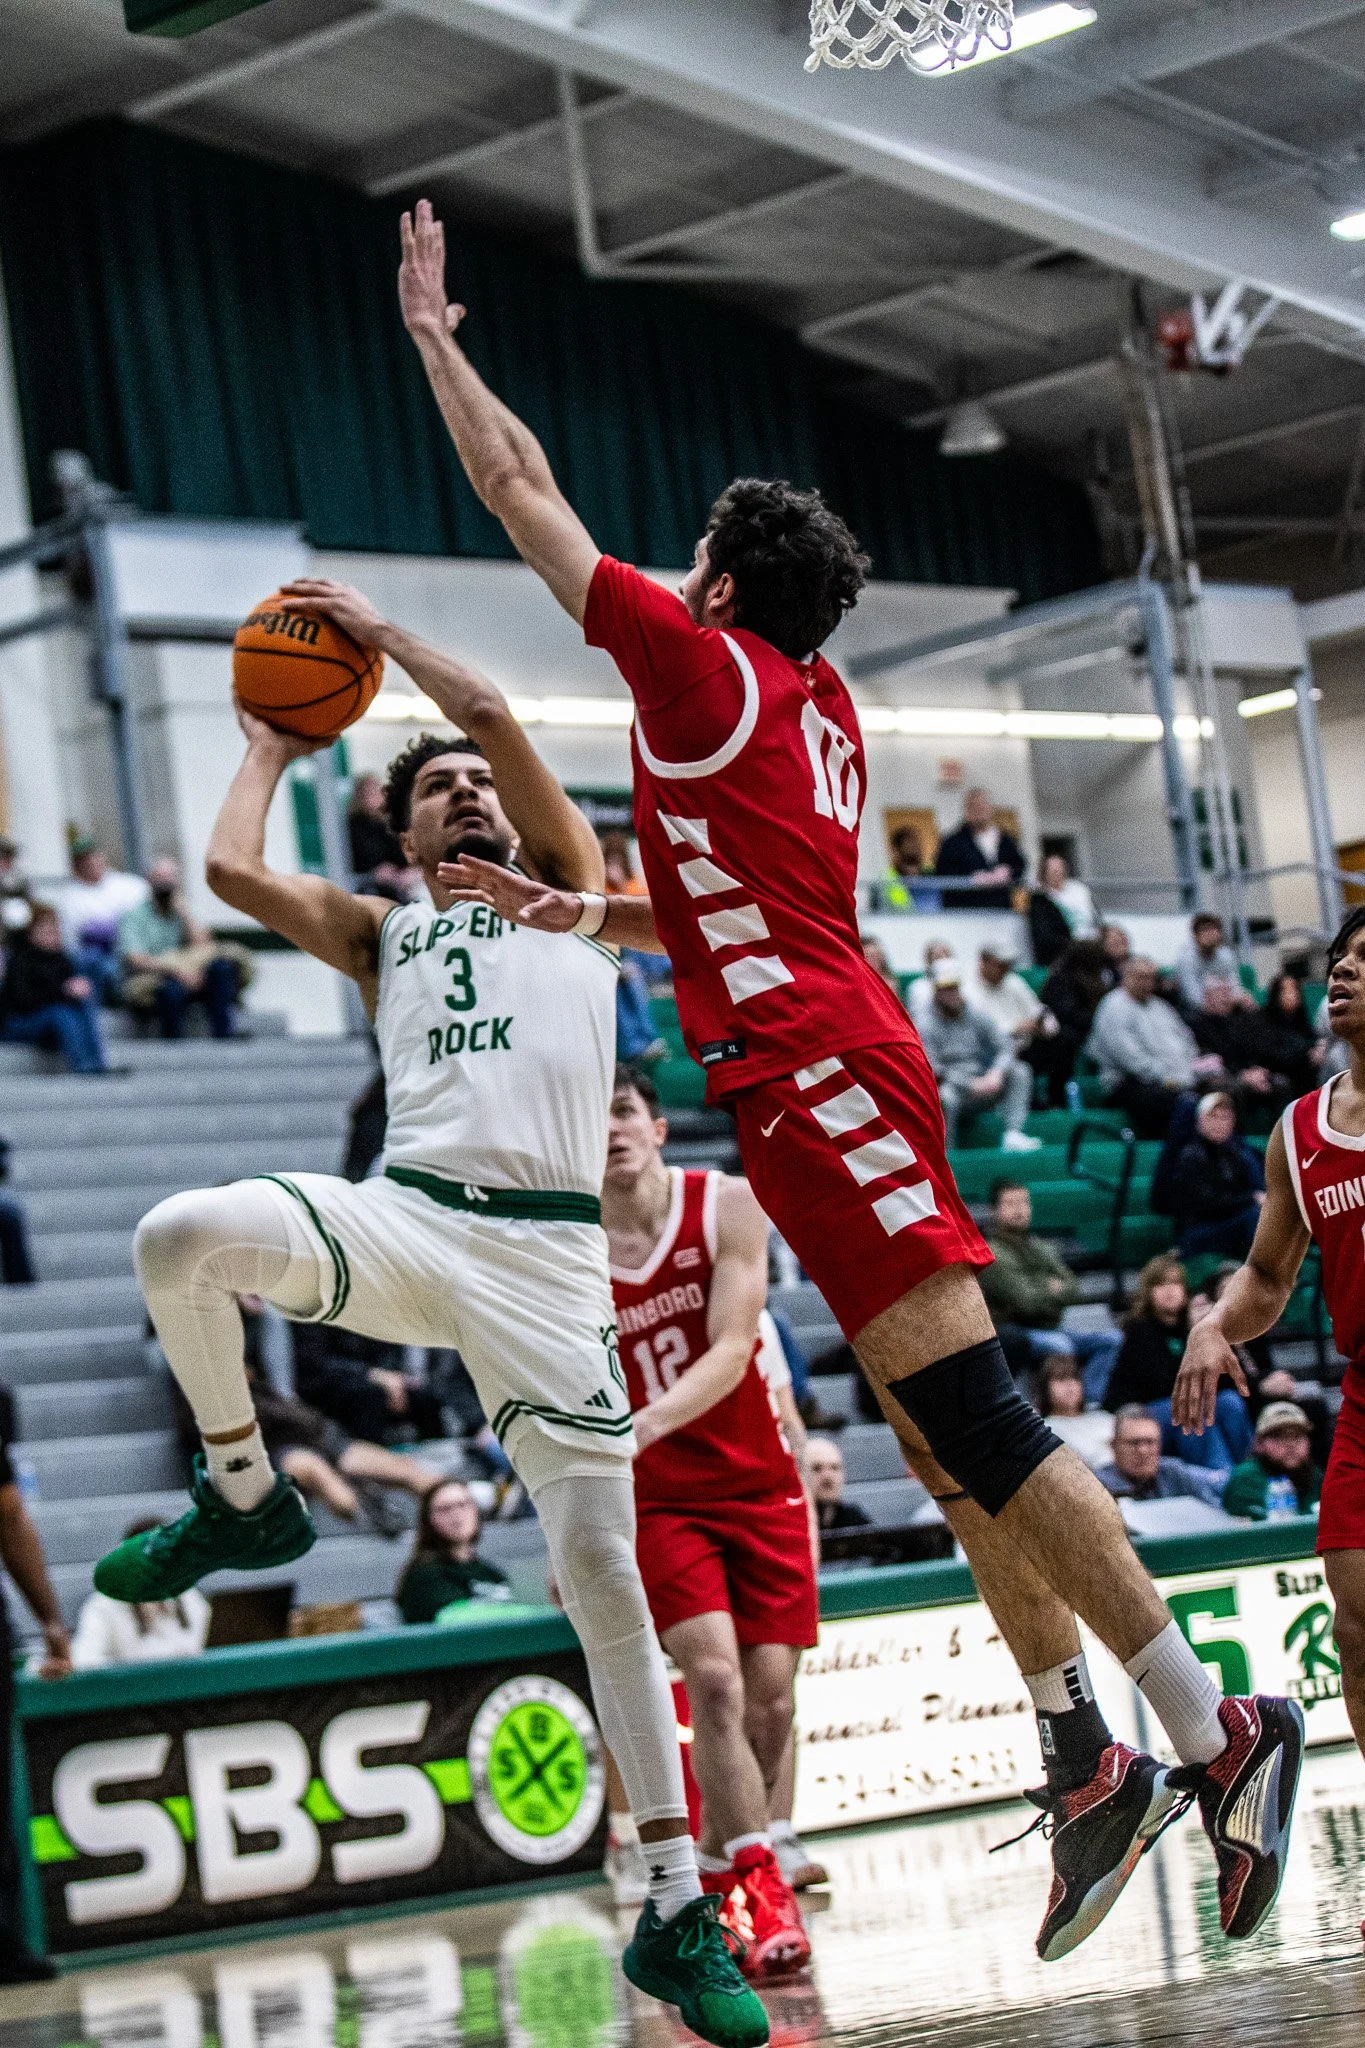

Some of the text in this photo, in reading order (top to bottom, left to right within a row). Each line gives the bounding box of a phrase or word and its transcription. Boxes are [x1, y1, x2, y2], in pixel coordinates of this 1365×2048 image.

[801, 698, 857, 833] 10
[444, 947, 477, 1012] 3
[428, 1016, 514, 1065] ROCK
[727, 1044, 739, 1053] XL
[1314, 1175, 1365, 1219] EDIN
[633, 1325, 690, 1403] 12
[52, 1700, 447, 1926] SBS
